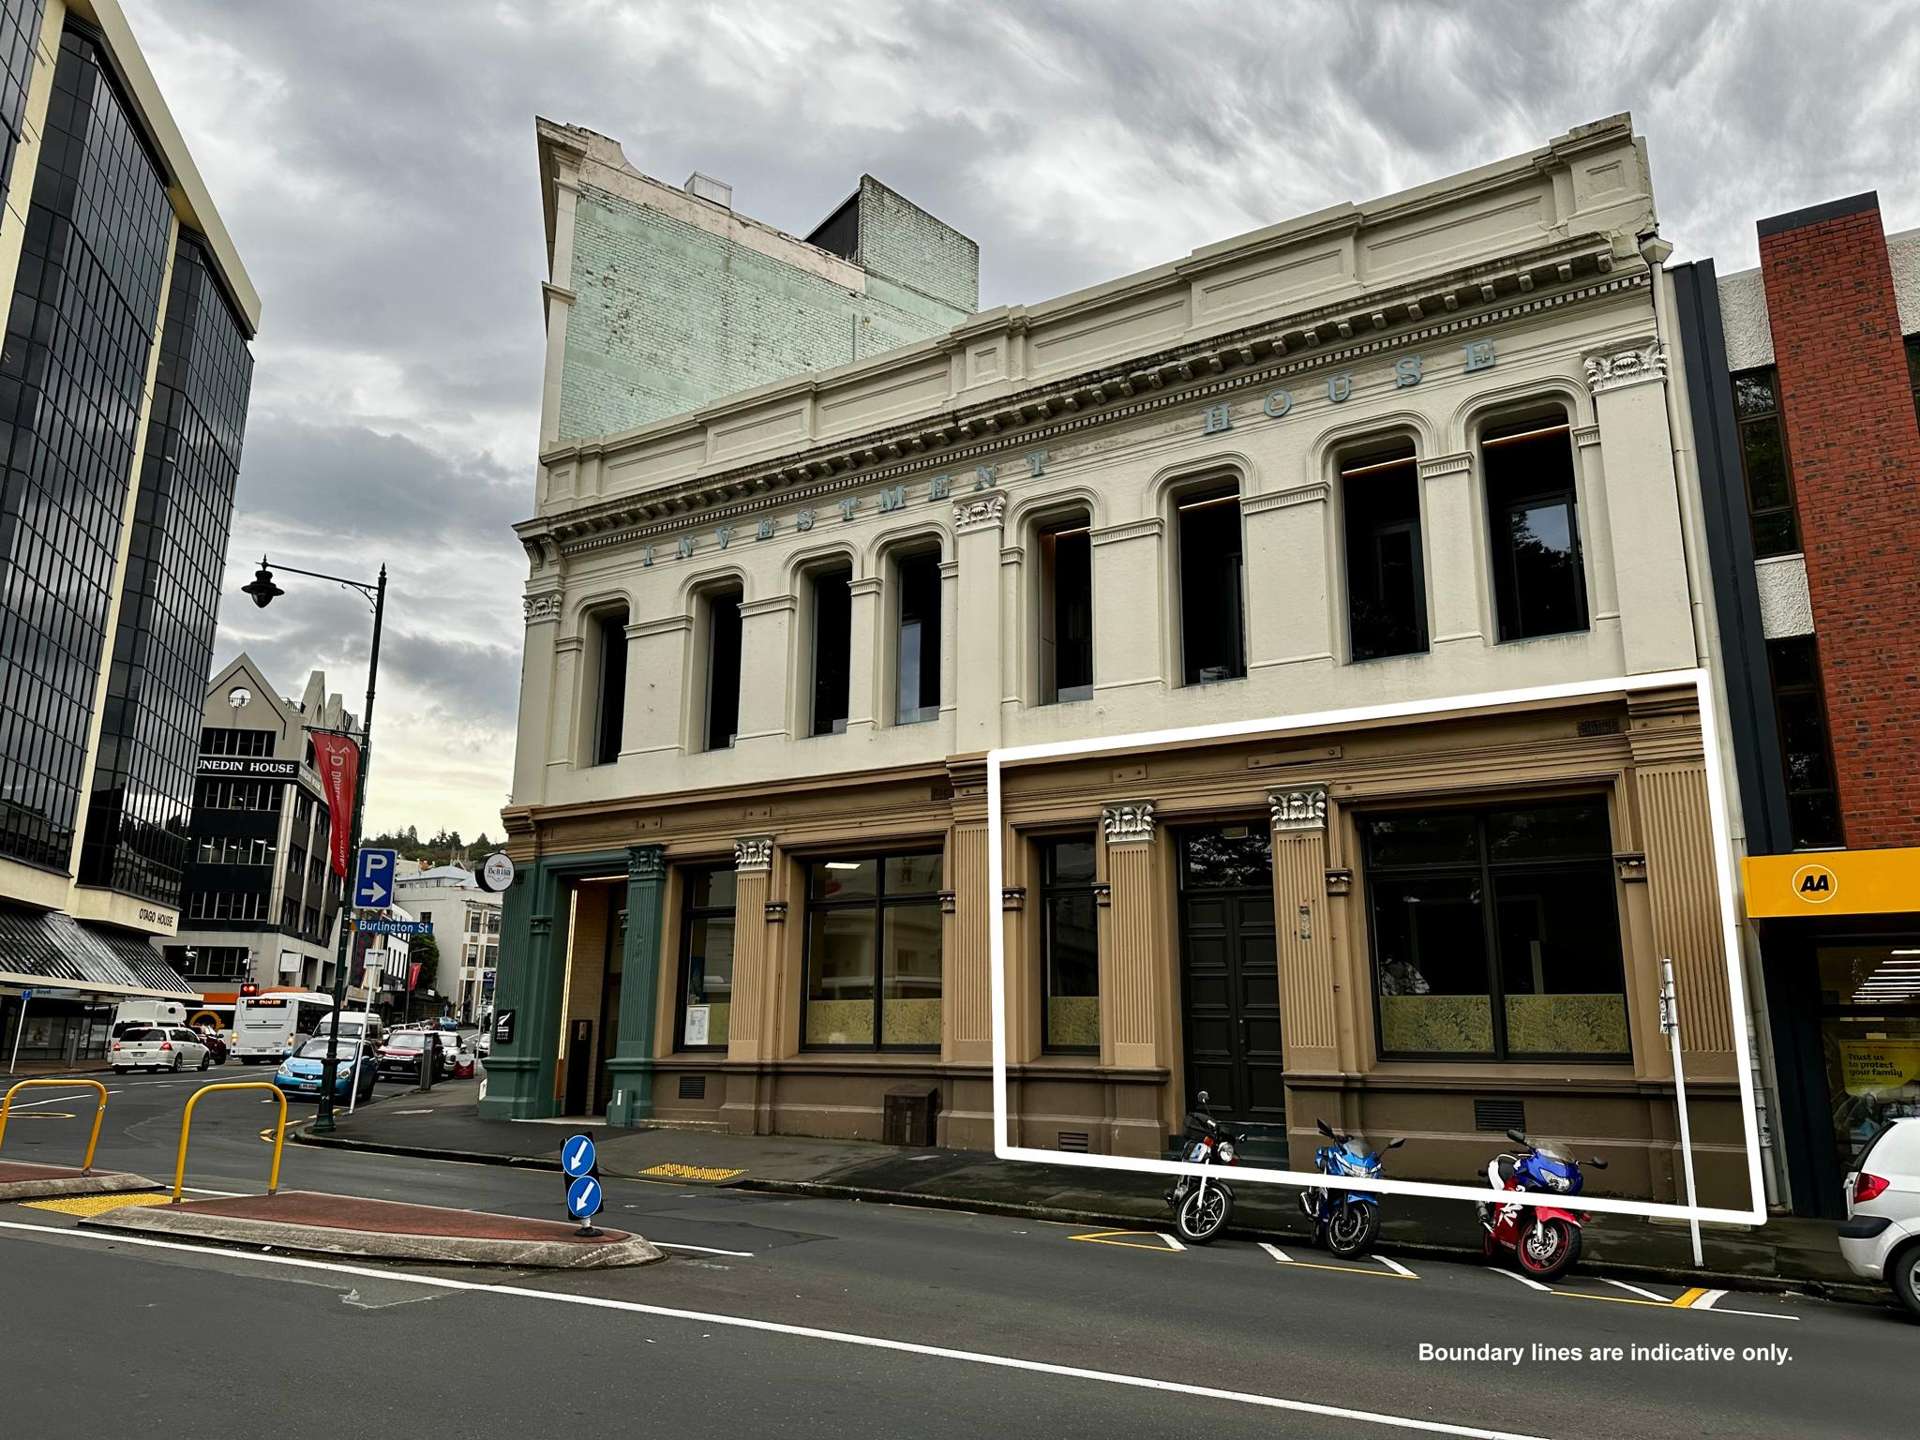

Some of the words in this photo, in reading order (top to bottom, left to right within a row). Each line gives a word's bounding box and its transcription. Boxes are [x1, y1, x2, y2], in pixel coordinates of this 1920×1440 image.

[641, 449, 1051, 568] INVESTMENT
[1202, 336, 1497, 437] HOUSE
[197, 760, 244, 772] UNEDIN
[249, 762, 295, 774] HOUSE
[365, 854, 388, 878] P
[1800, 874, 1830, 892] AA
[139, 907, 156, 923] OTAGO
[157, 912, 174, 928] HOUSE
[359, 920, 414, 933] Burlington
[417, 922, 429, 933] St
[1849, 1069, 1871, 1078] your
[1872, 1068, 1904, 1079] family
[1860, 1061, 1895, 1070] protect
